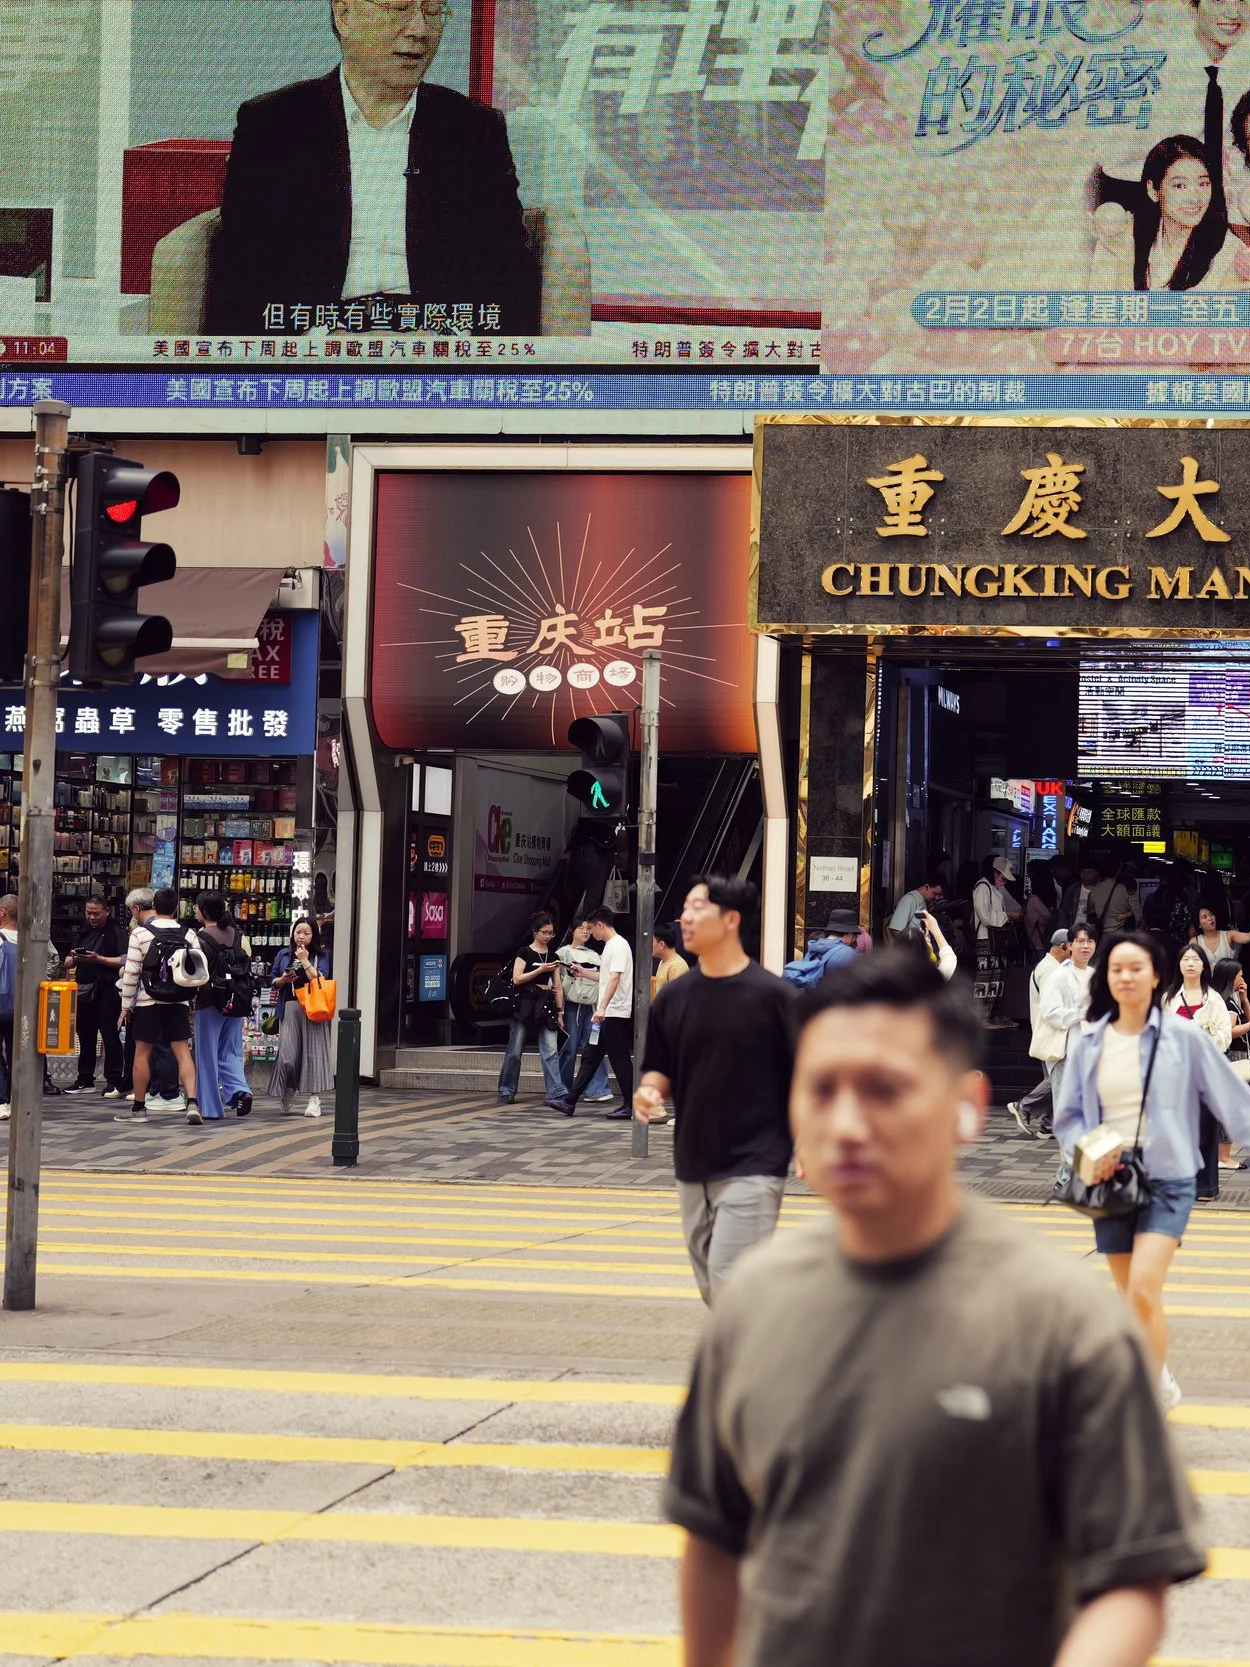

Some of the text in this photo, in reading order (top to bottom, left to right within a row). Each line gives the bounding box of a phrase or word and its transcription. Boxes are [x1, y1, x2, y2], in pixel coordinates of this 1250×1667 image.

[913, 46, 1168, 156] 的秘密
[261, 302, 502, 331] 但有時有些實際環境
[924, 296, 1049, 324] 2月2日起
[1059, 296, 1240, 324] 逢星期一至五
[13, 341, 56, 355] 11:04
[1060, 332, 1247, 358] 77台 HOY TV
[166, 377, 595, 404] 美國宣布下周起上調歐盟汽車關稅至25%
[821, 563, 1131, 600] CHUNGKING
[259, 618, 286, 642] 稅
[454, 602, 668, 663] 重庆站
[251, 645, 281, 661] AX
[500, 666, 632, 688] 购物商场
[157, 706, 290, 737] 零售批發
[1101, 808, 1161, 822] 全球匯款
[1101, 823, 1161, 838] 大額面議
[814, 864, 855, 872] Nathan Road
